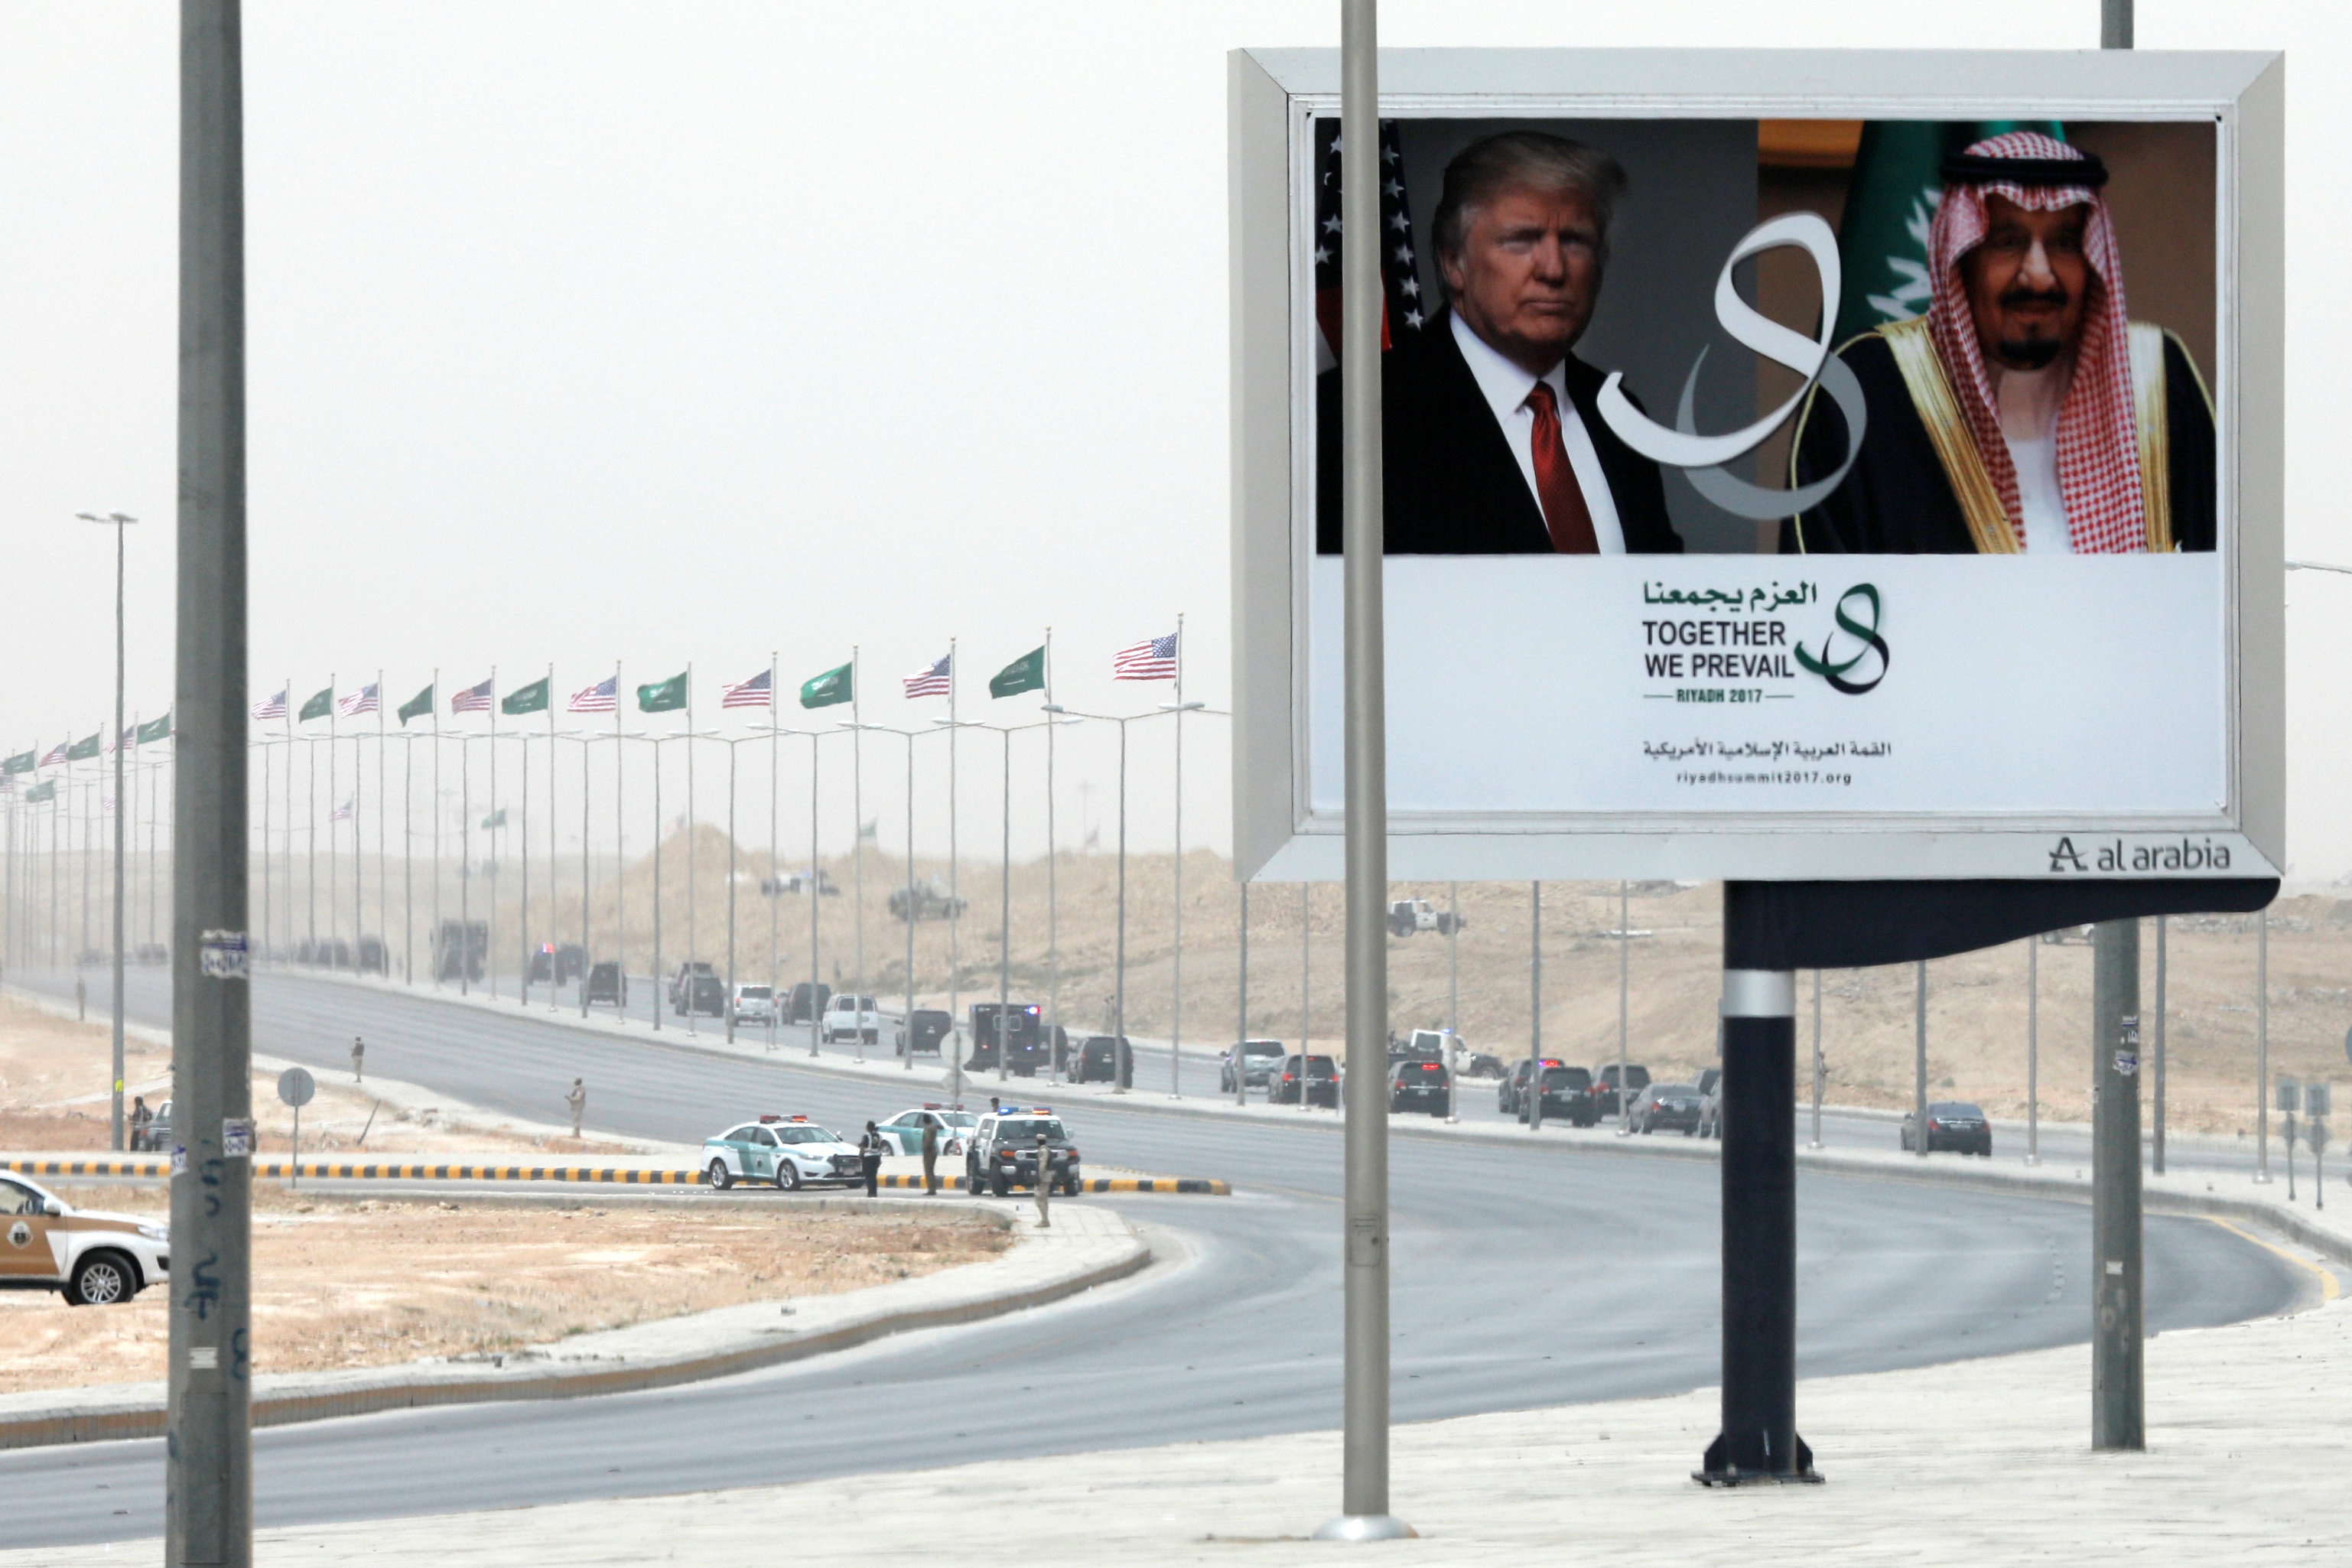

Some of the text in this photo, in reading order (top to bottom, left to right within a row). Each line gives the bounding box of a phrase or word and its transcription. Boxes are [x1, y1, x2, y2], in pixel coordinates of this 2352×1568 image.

[1643, 580, 1818, 613] العزم يجمعنا
[1642, 620, 1787, 646] TOGETHER
[1644, 653, 1795, 678] WE PREVAIL
[1677, 688, 1762, 703] RIYADH 2017
[1643, 738, 1892, 762] القمة العربية الإسلامية الأمريكية
[1676, 770, 1852, 786] riyadhsummit2017.org
